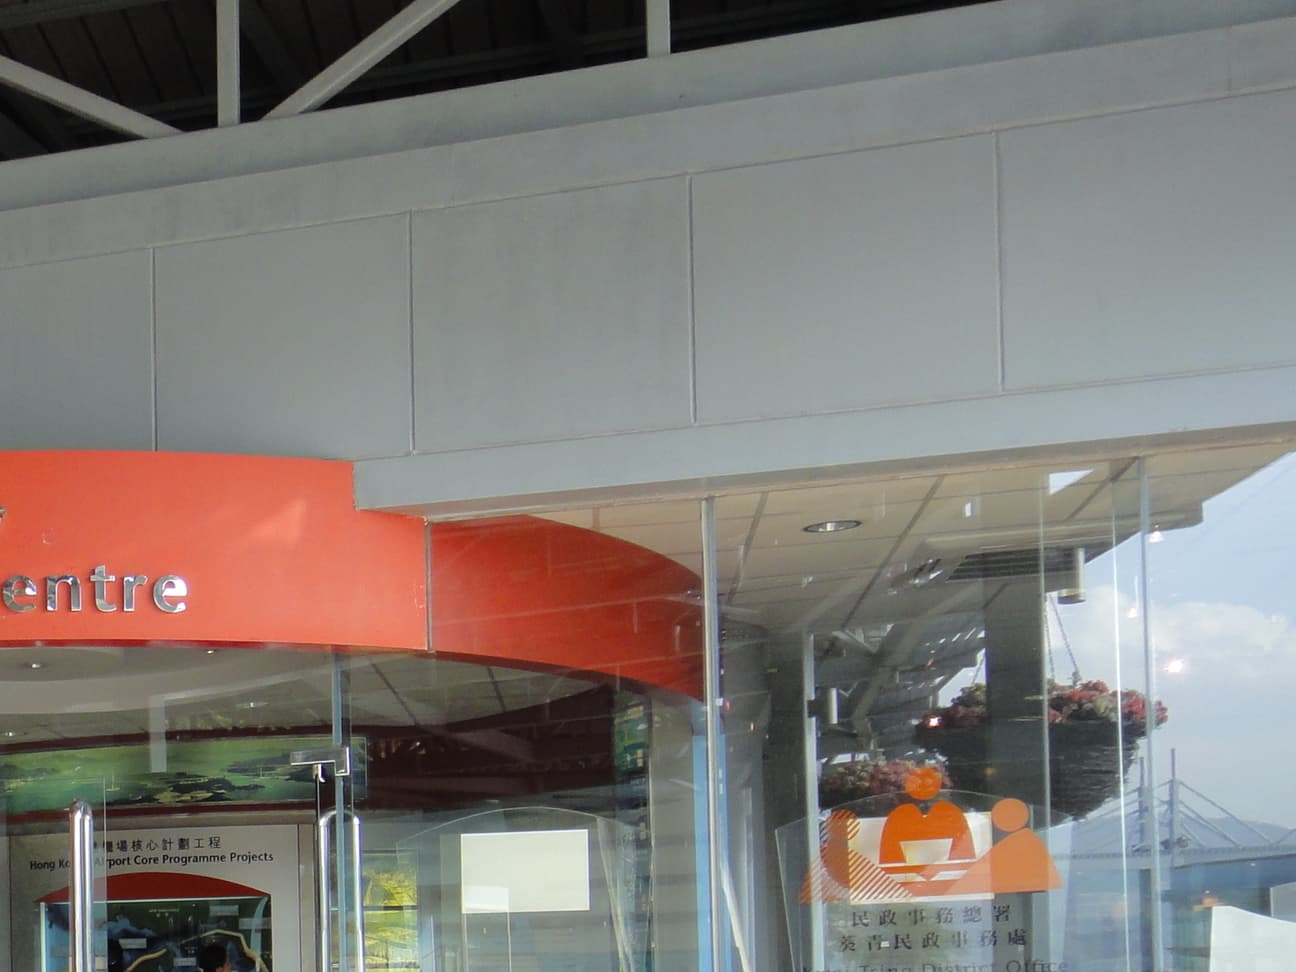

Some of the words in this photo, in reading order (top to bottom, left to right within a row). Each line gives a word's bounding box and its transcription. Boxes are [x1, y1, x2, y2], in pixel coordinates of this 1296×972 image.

[92, 836, 221, 853] 機場核心計劃工程
[30, 861, 56, 872] Hong
[134, 855, 159, 865] Core
[162, 853, 227, 866] Programme
[230, 851, 274, 864] Projects
[852, 904, 1011, 927] 民政事務總署
[840, 929, 1027, 951] 葵青民政事務處
